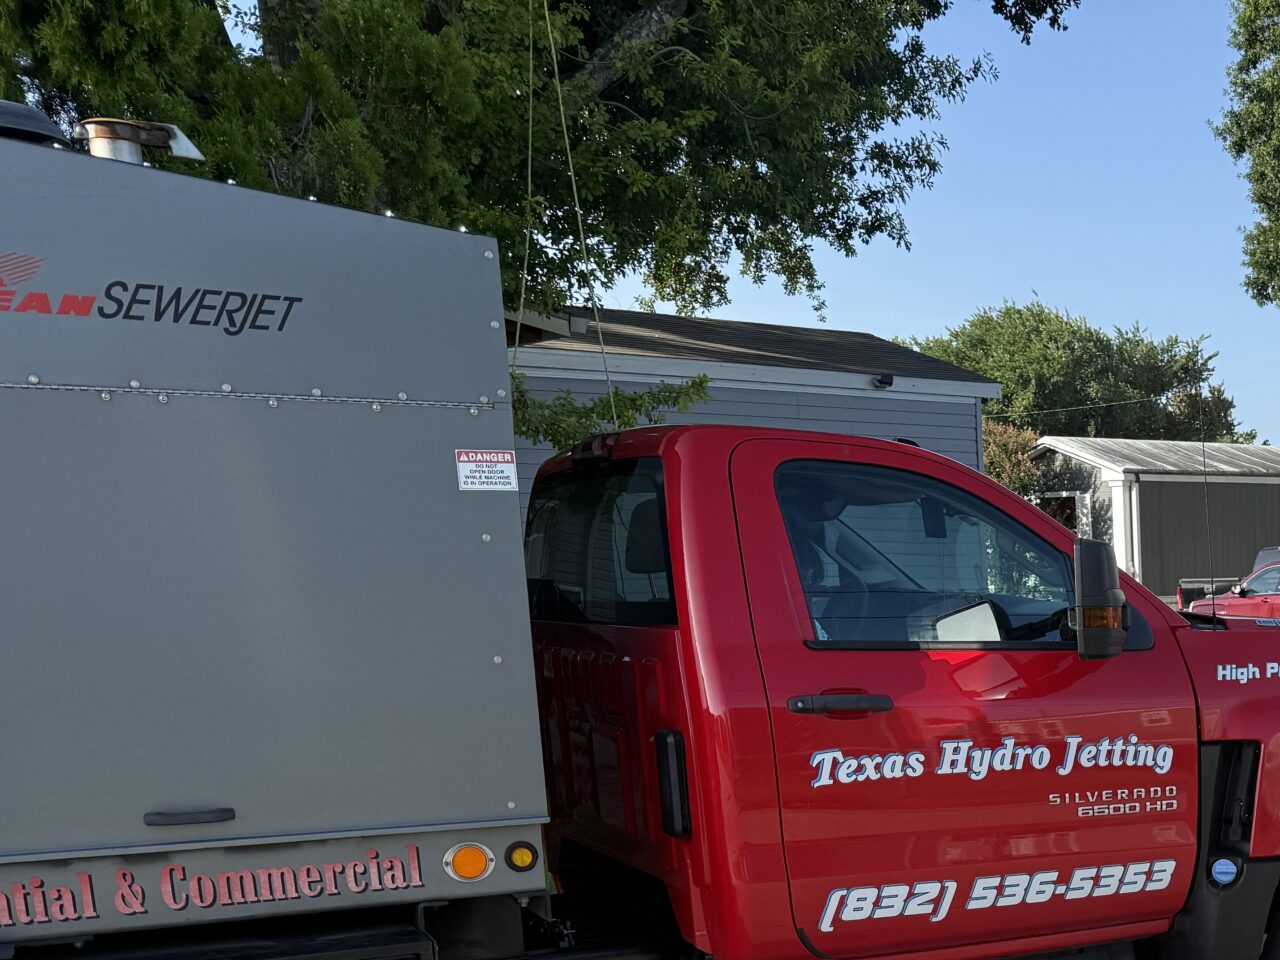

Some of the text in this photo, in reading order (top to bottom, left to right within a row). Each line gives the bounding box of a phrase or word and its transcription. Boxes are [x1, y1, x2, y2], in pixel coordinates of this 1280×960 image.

[97, 280, 303, 337] SEWERJET
[469, 453, 511, 462] DANGER
[1217, 663, 1261, 684] High
[810, 733, 1175, 789] Texas Hydro Jetting
[1048, 785, 1178, 806] SILVERADO
[1077, 799, 1179, 818] 6500 HD
[113, 867, 148, 915] &
[159, 843, 425, 912] Commercial
[817, 859, 1177, 933] (832) 536-5353
